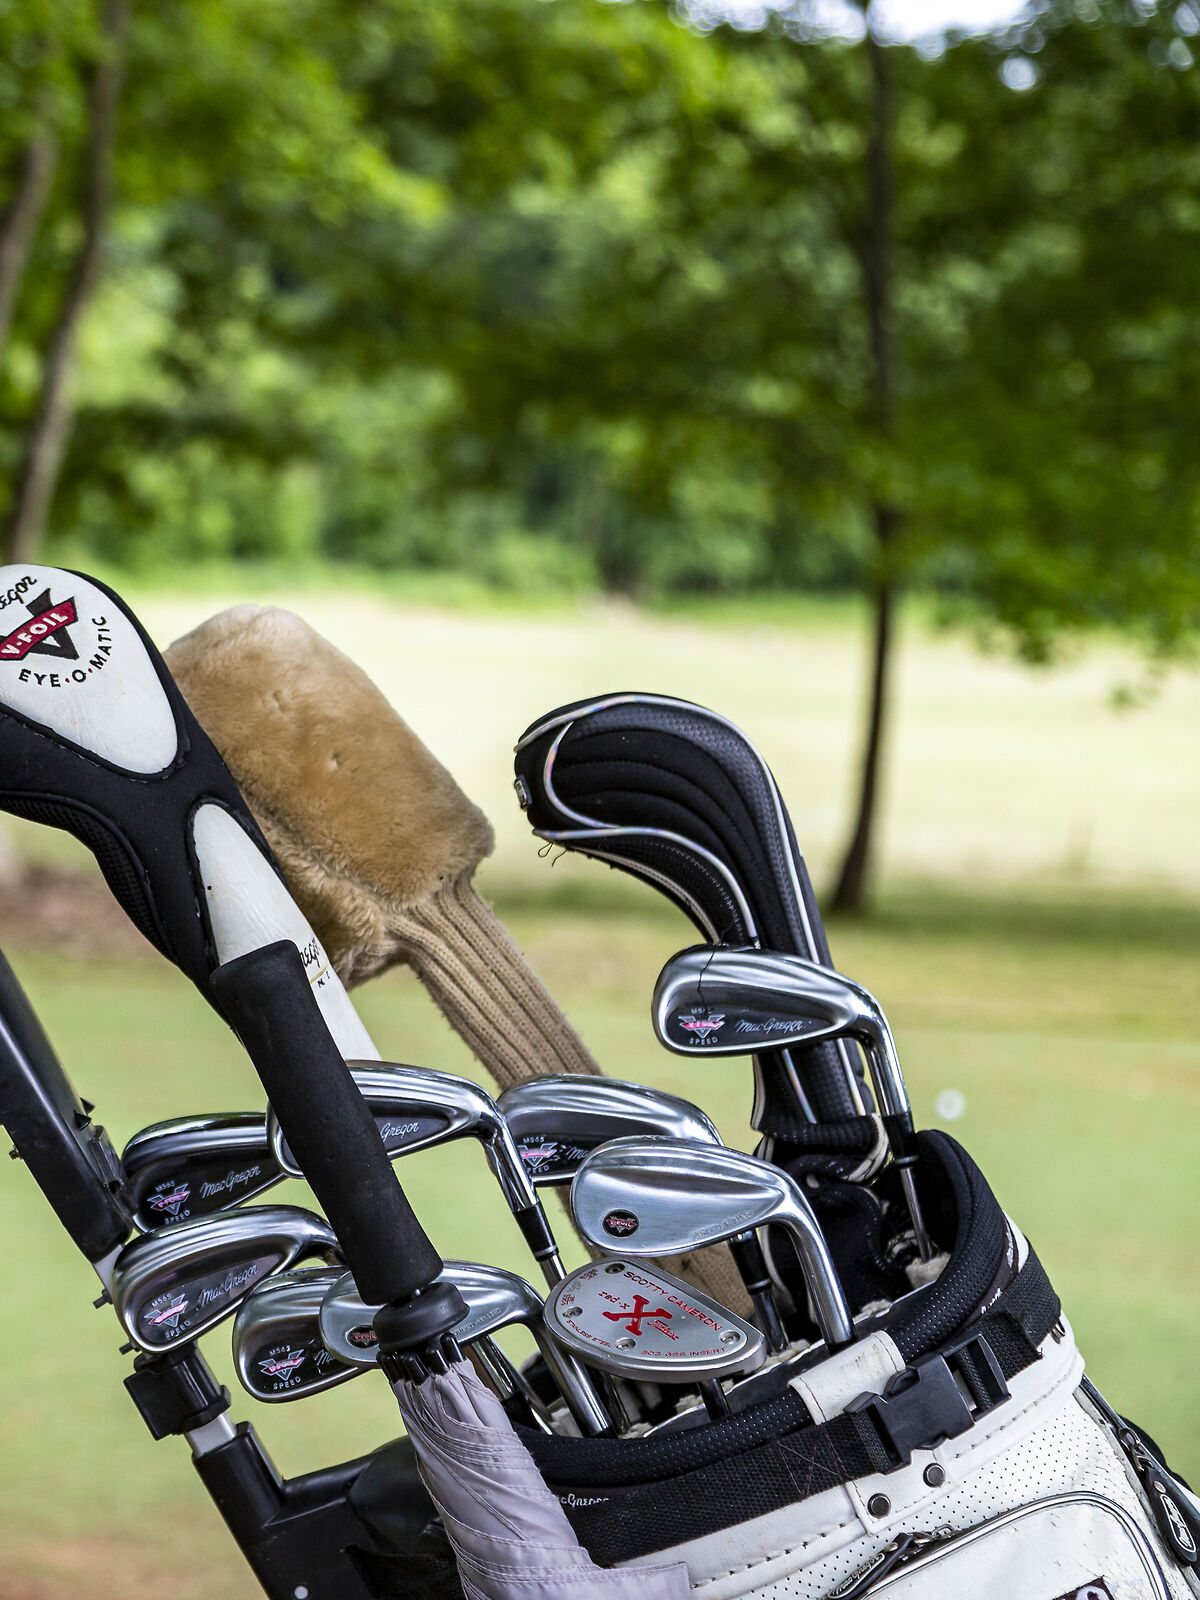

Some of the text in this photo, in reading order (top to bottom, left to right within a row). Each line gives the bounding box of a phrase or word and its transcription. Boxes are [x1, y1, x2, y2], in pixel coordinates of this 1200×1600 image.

[689, 1036, 718, 1046] SPEED
[380, 1122, 419, 1143] Gregor
[526, 1164, 550, 1175] PEED
[199, 1165, 262, 1199] MacGregor
[164, 1209, 191, 1225] SPEED
[198, 1263, 259, 1308] MacGregor
[623, 1271, 723, 1332] SCOTTY CAMERON
[689, 1346, 726, 1357] INSERT
[273, 1376, 301, 1390] SPEED
